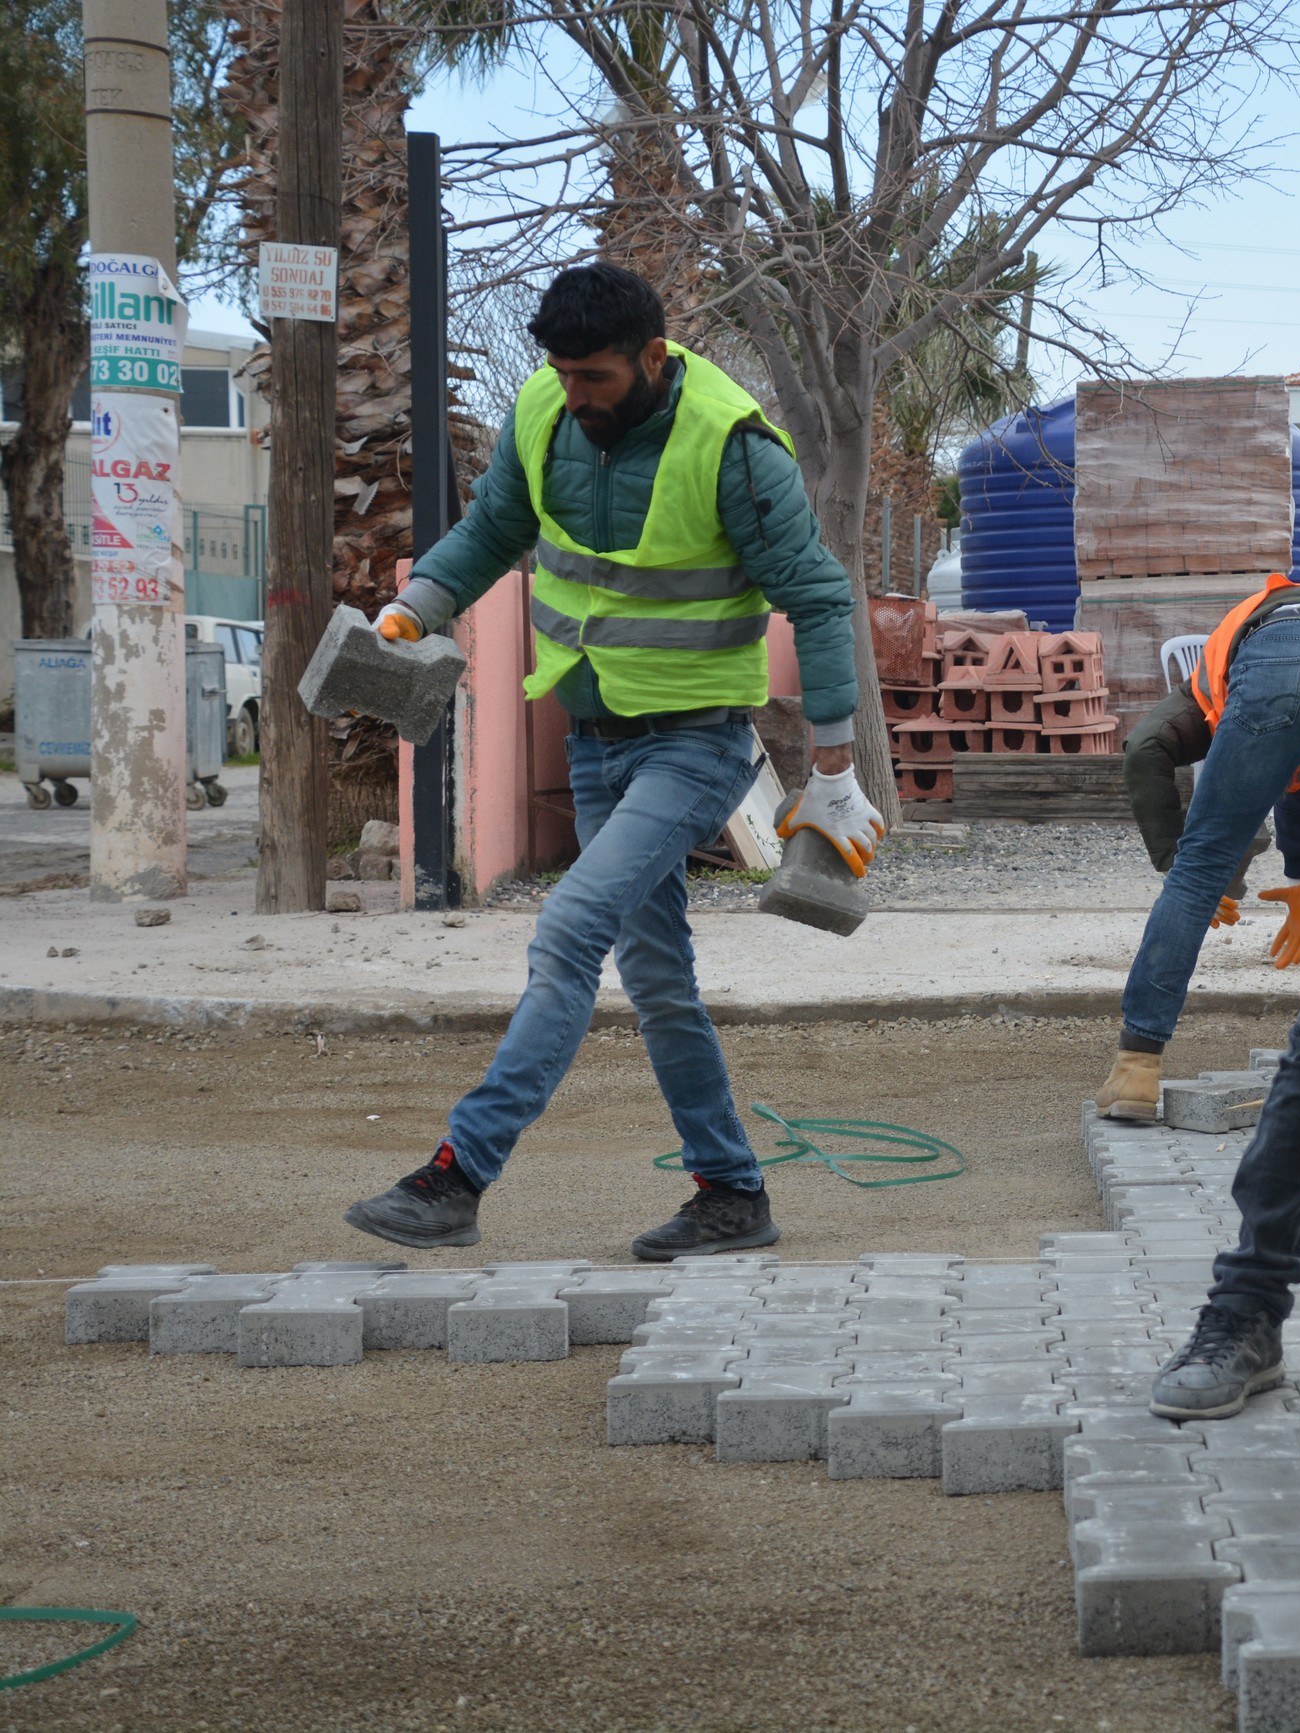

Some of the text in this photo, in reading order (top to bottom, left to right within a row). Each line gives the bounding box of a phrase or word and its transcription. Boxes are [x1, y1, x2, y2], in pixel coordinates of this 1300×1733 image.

[314, 251, 332, 266] SU
[271, 267, 324, 286] SONDAJ
[104, 322, 137, 330] SATICI
[124, 346, 160, 357] HATTI
[117, 360, 149, 382] 30
[114, 482, 138, 503] 13
[135, 577, 159, 601] 93
